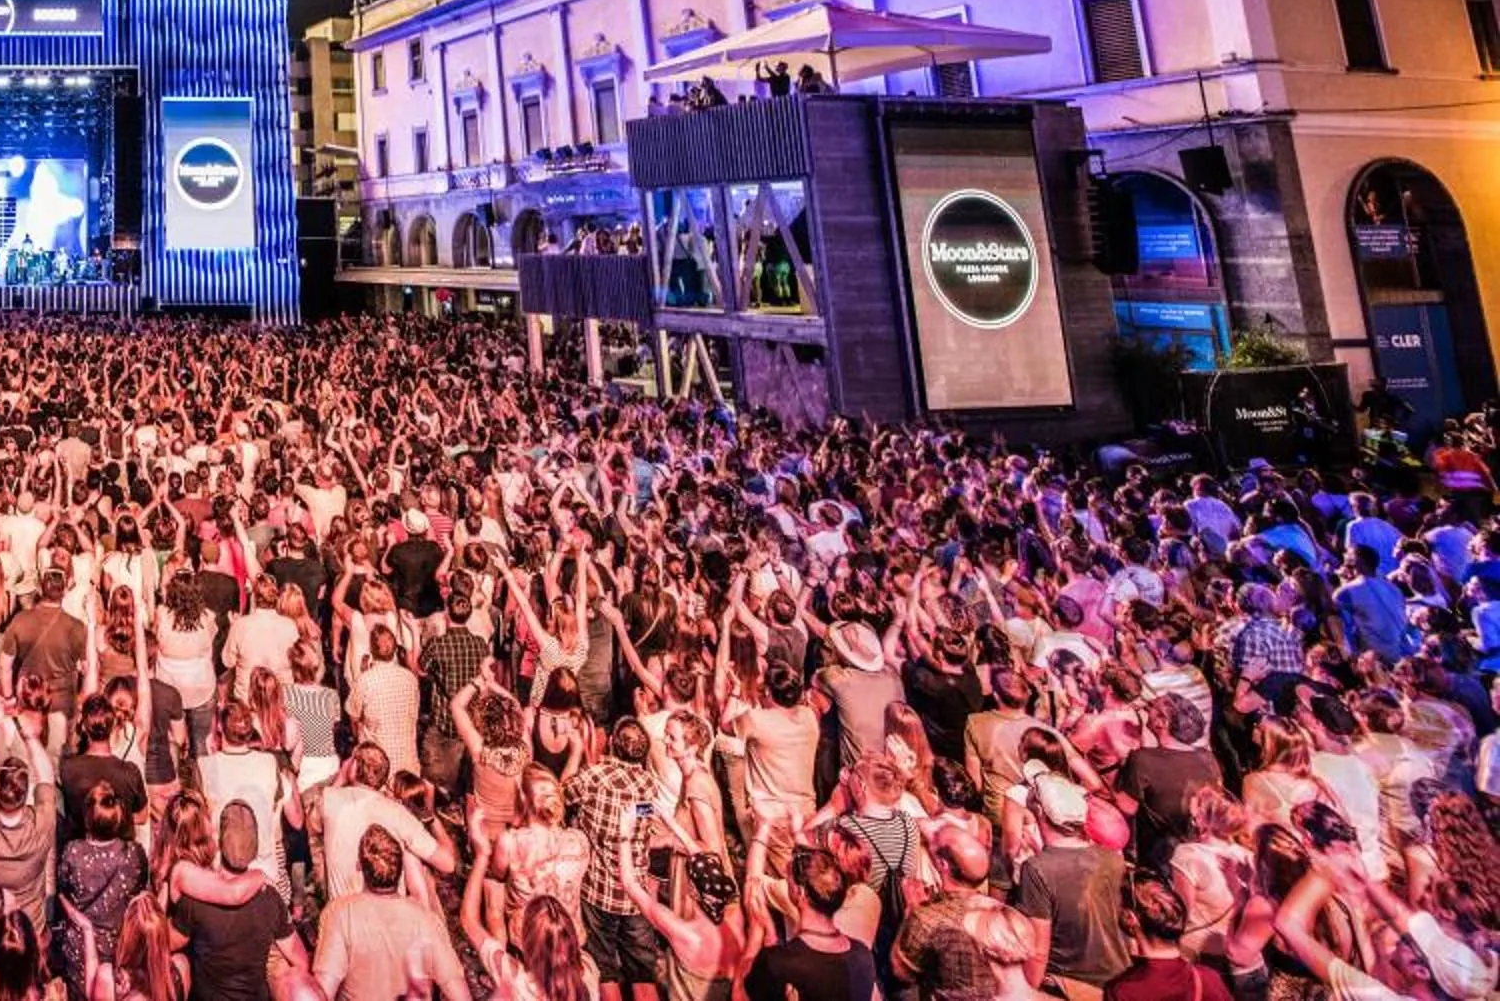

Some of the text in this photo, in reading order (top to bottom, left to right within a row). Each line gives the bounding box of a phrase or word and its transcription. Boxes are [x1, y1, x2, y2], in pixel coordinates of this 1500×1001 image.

[929, 242, 1028, 262] Moon&Stars
[1391, 334, 1421, 348] CLER
[1235, 406, 1287, 420] Moon&St
